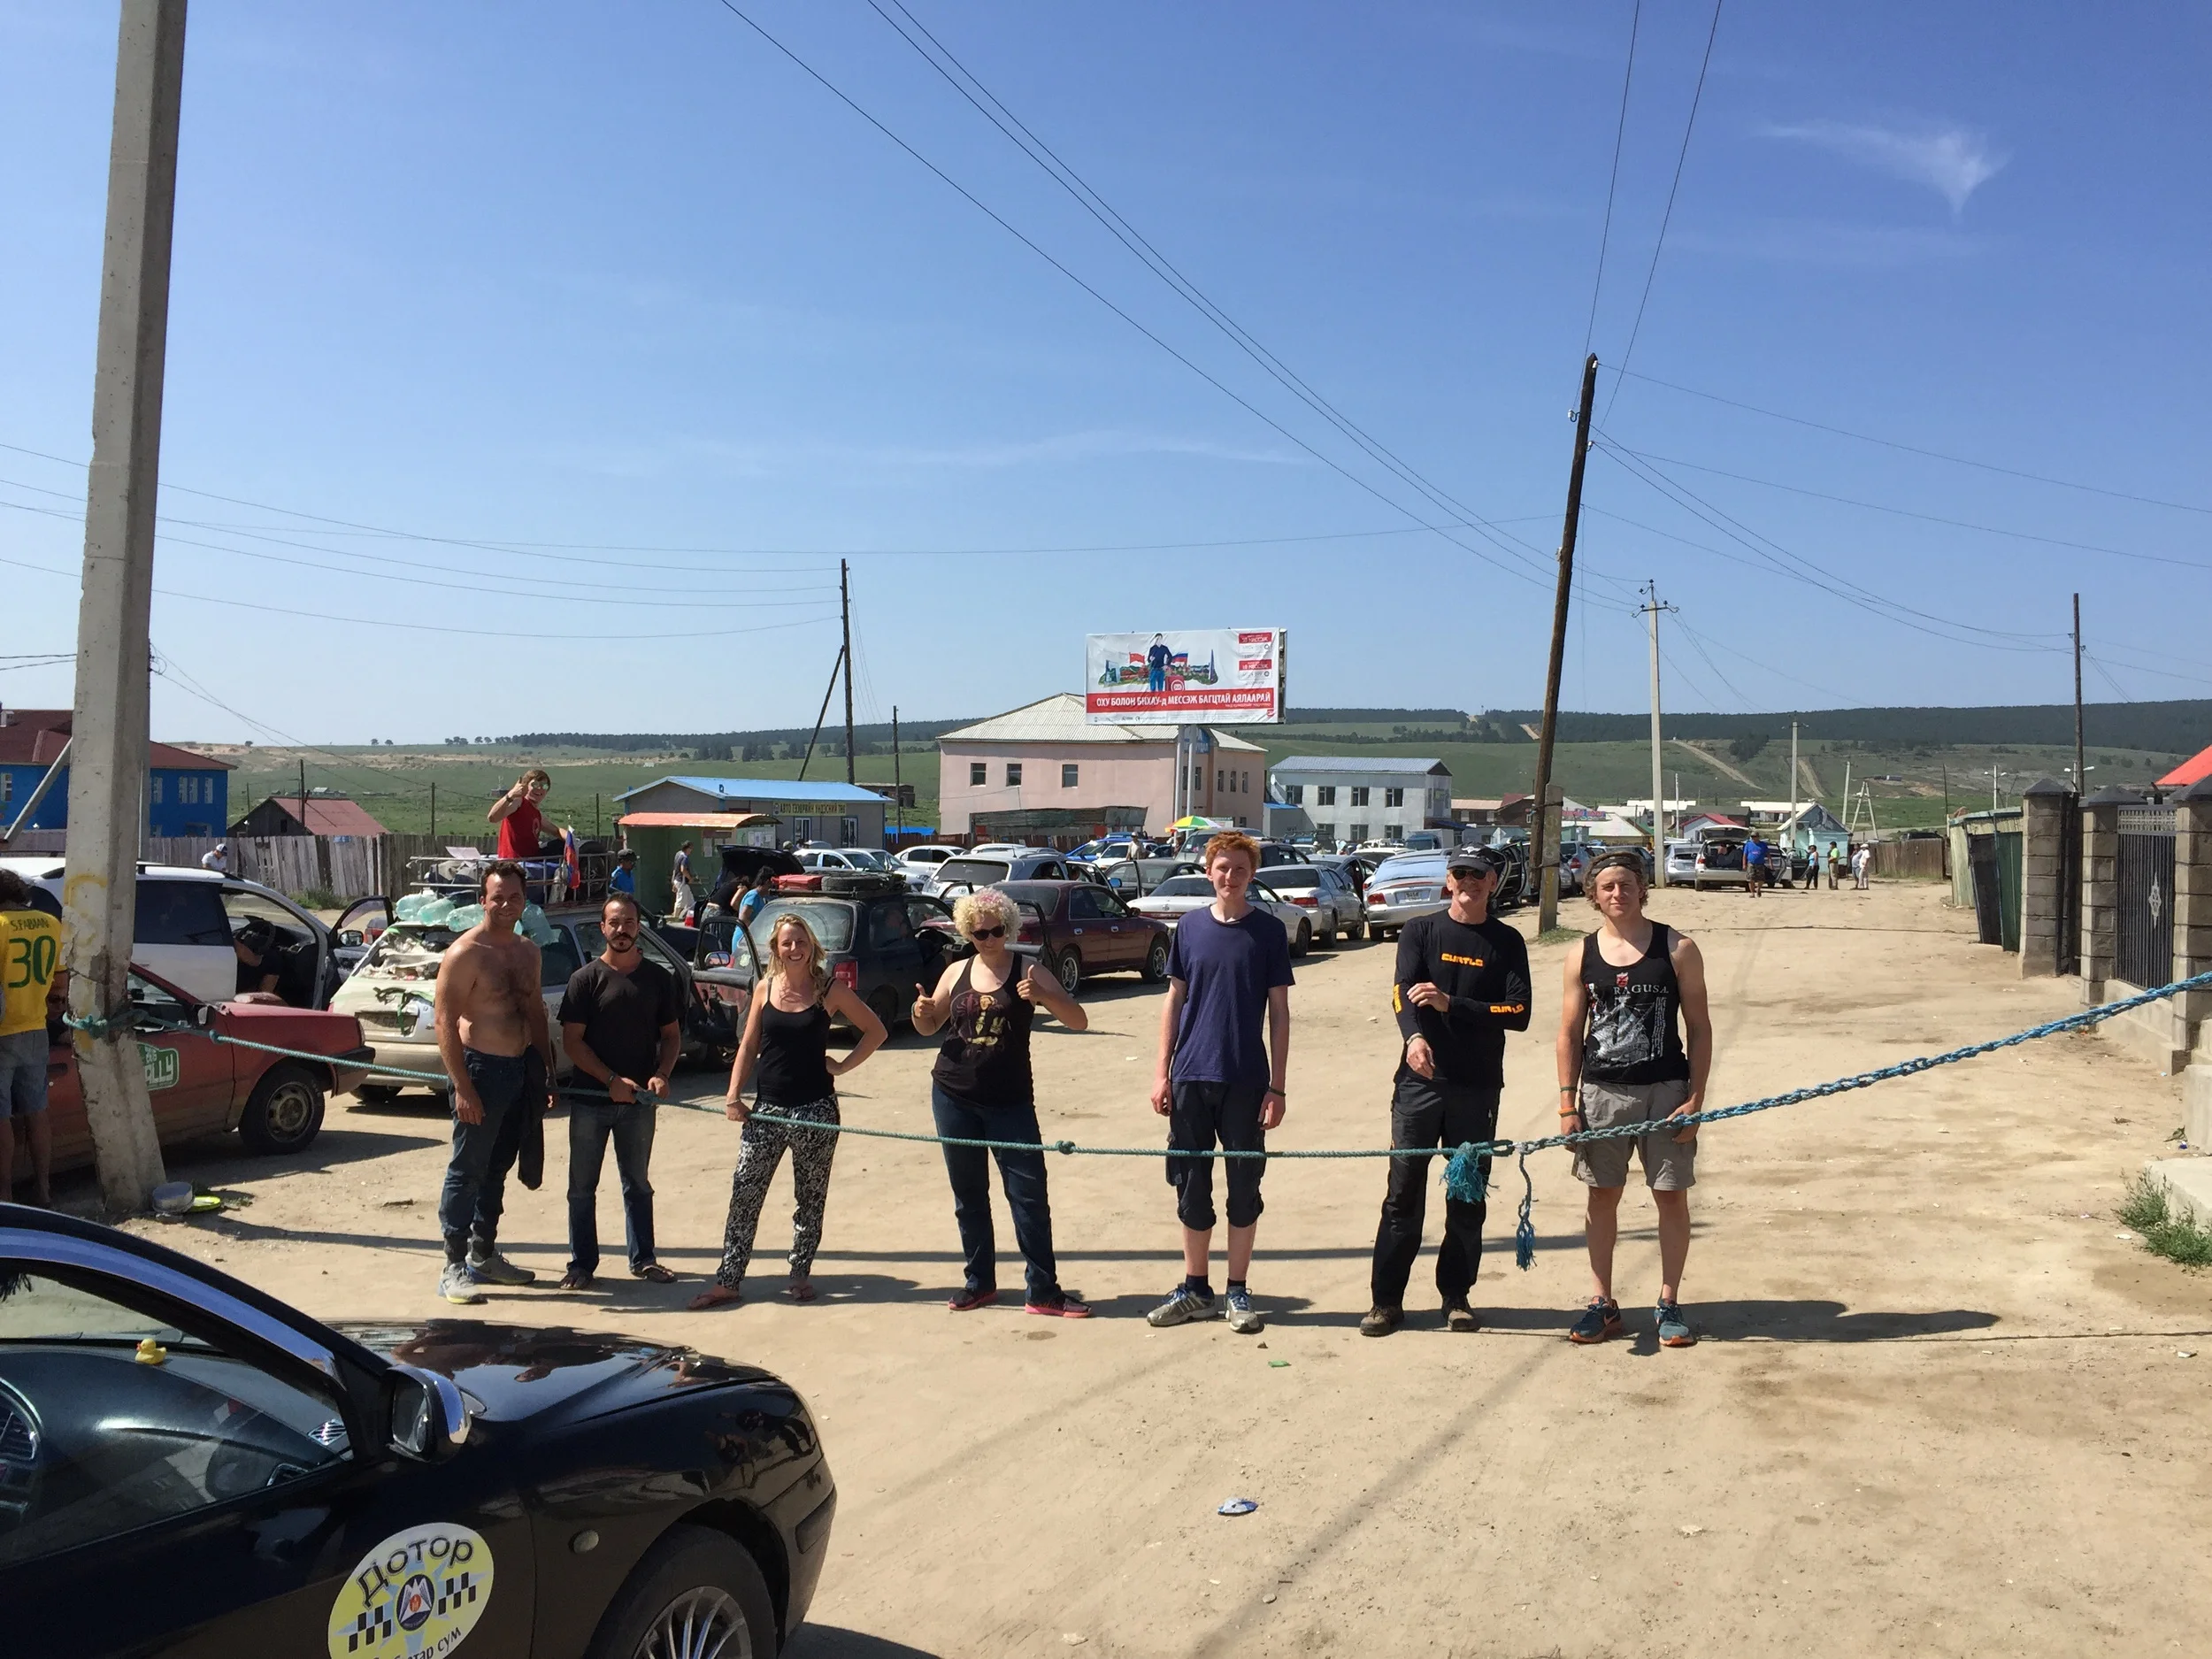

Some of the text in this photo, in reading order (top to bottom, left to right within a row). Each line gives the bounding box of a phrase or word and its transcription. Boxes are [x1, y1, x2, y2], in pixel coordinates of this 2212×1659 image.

[1096, 697, 1110, 707] ОХУ
[1110, 696, 1136, 707] БОЛОН
[1137, 695, 1167, 707] БНХАУ-д
[1168, 695, 1197, 705] МЕССЭЖ
[1198, 693, 1231, 705] БАГЦТАЙ
[1232, 692, 1271, 703] АЯЛААРАЙ
[8, 935, 56, 988] 30
[1613, 984, 1669, 995] RAGUSA
[437, 1626, 462, 1653] сум
